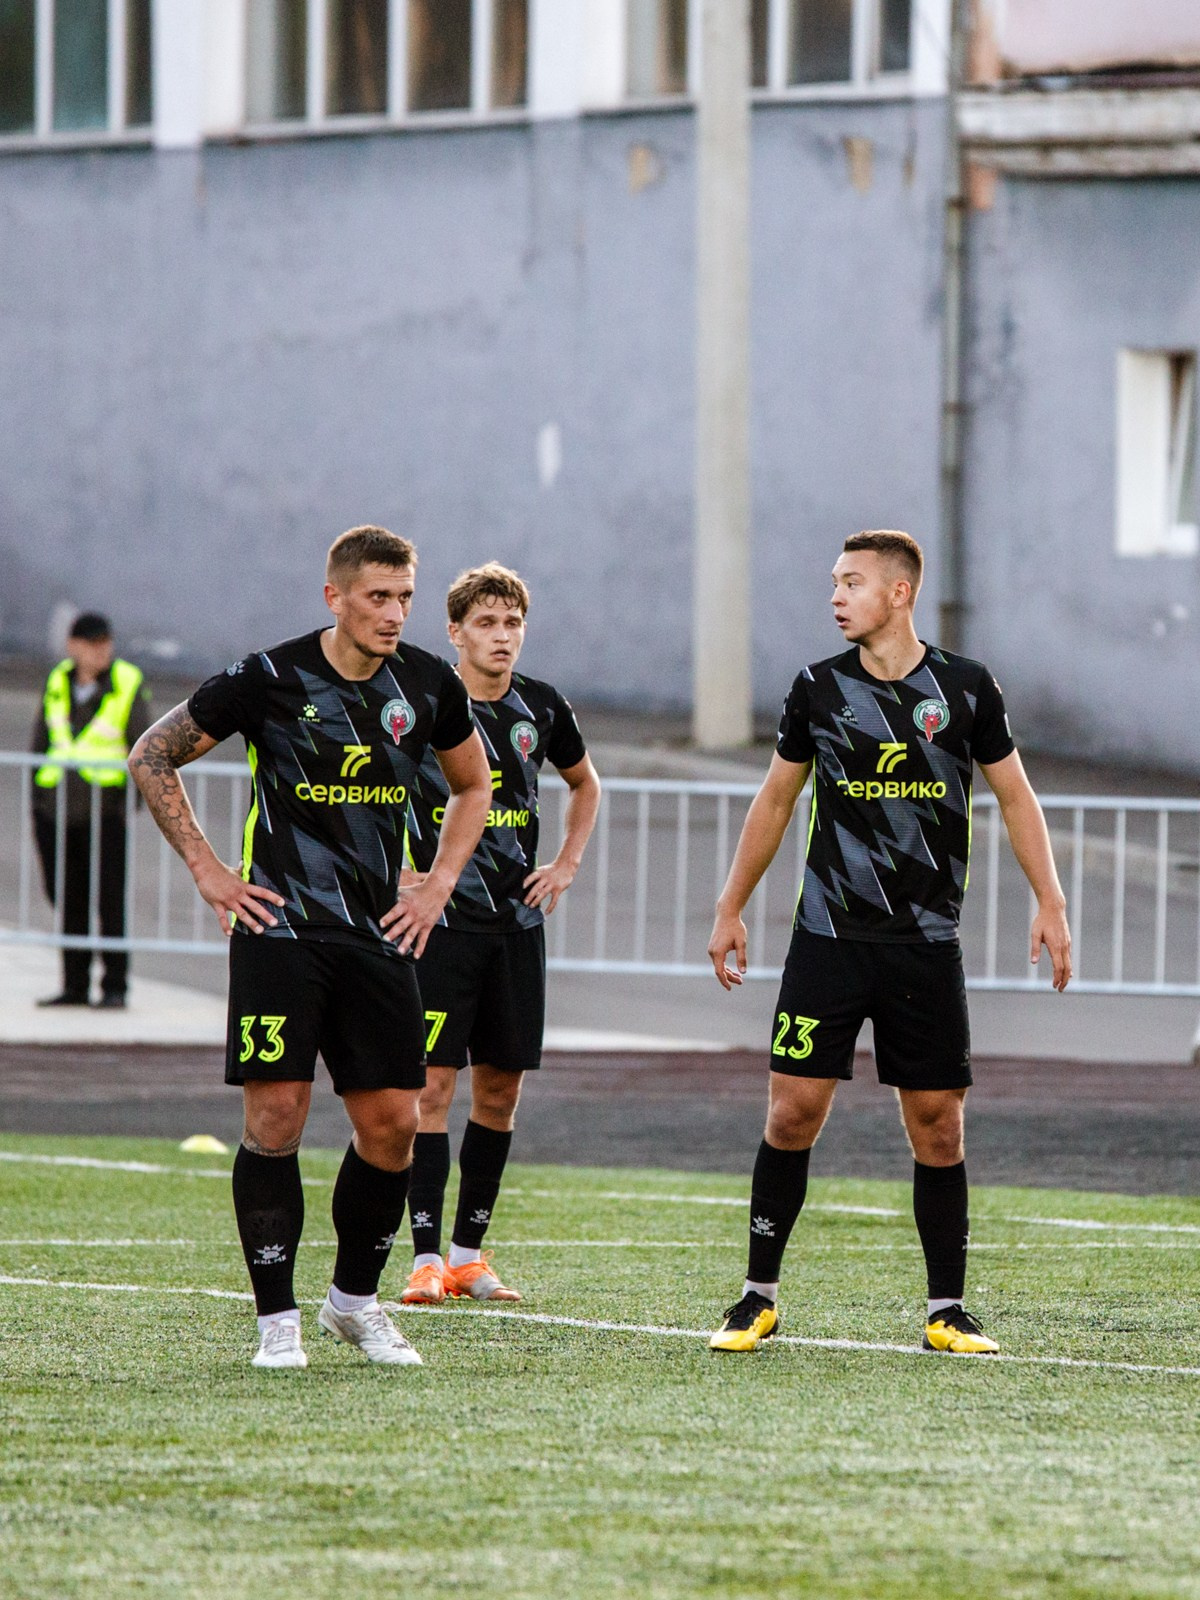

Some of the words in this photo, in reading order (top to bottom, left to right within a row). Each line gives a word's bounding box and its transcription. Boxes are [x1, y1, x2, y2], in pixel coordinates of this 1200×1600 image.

[295, 782, 406, 805] сервико
[432, 807, 530, 828] свико
[239, 1015, 287, 1062] 33
[772, 1011, 821, 1060] 23
